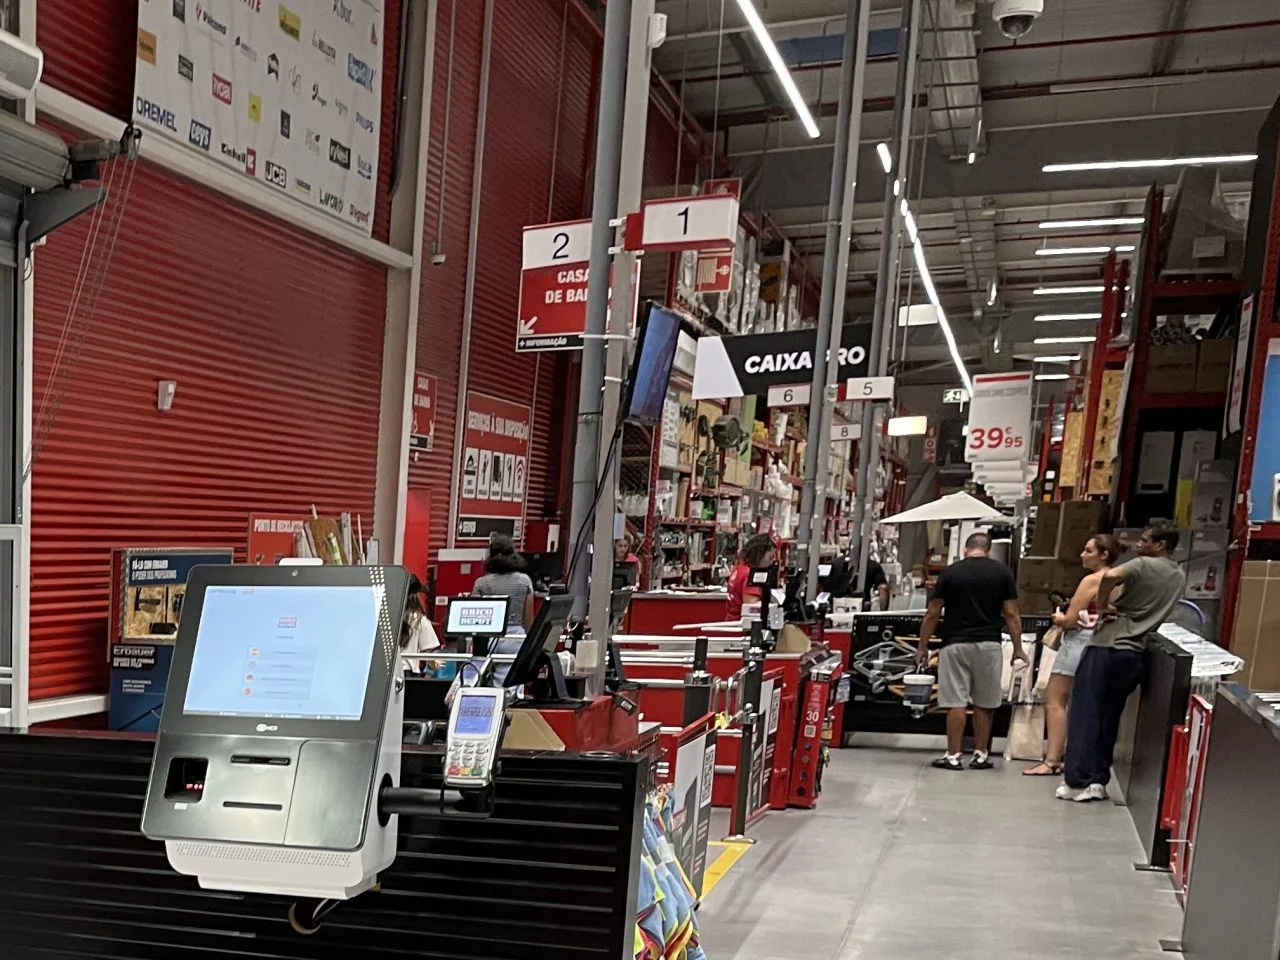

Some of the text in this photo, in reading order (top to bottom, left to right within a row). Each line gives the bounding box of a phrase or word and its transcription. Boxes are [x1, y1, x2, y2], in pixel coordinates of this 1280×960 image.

[136, 96, 177, 132] DREMEL
[266, 163, 285, 187] JCB
[677, 206, 689, 235] 1
[552, 232, 570, 260] 2
[545, 290, 562, 304] DE
[744, 346, 865, 374] CAIXA RO
[783, 389, 793, 402] 6
[863, 381, 873, 396] 5
[841, 427, 848, 438] 8
[114, 646, 155, 656] Erbauer
[806, 711, 819, 722] 30
